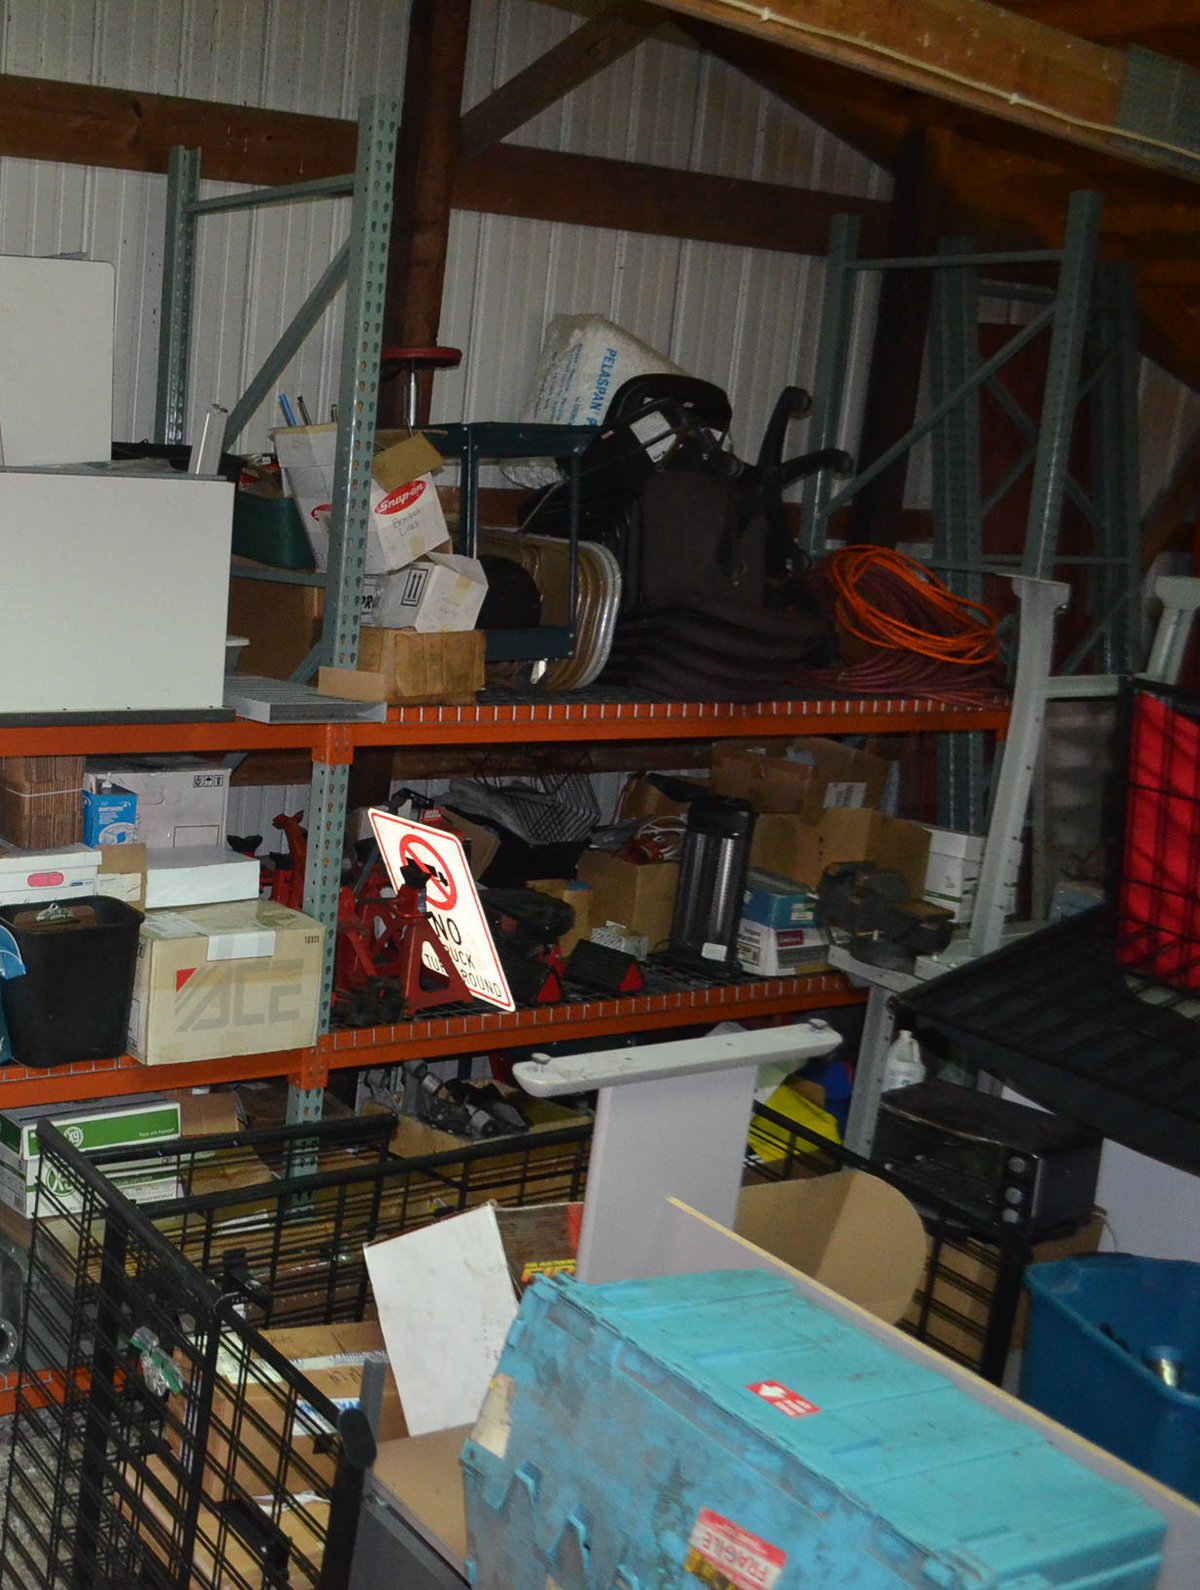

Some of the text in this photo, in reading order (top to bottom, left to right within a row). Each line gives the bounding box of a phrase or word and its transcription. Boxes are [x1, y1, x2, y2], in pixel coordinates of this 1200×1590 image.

[590, 348, 617, 411] PELASPAN
[377, 483, 425, 512] Snap-on
[432, 911, 462, 946] NO
[444, 944, 476, 970] UCK
[461, 969, 502, 997] ROUND
[702, 1532, 769, 1582] FRAGILE
